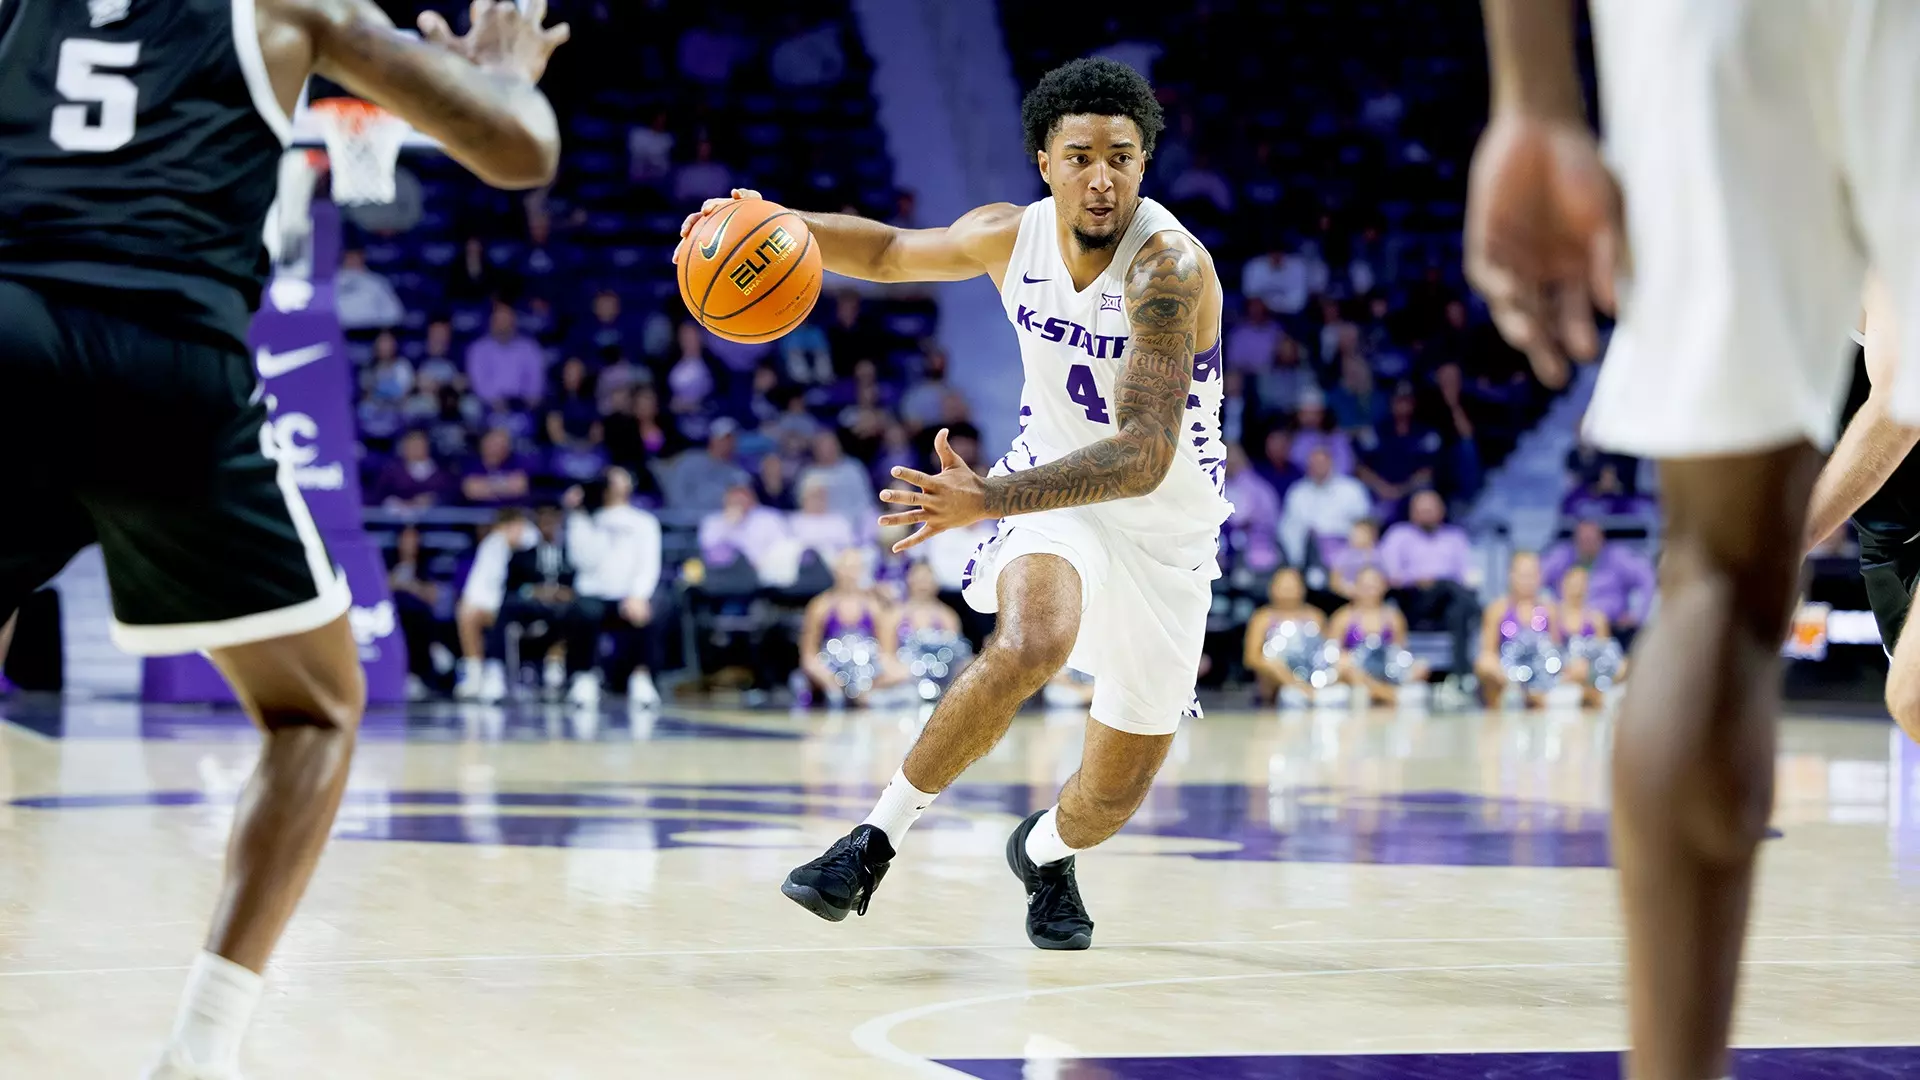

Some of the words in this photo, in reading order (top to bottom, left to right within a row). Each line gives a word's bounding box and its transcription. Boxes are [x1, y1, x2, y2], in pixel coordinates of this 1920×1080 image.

[50, 37, 141, 152] 5
[728, 225, 796, 292] ELITE
[743, 240, 799, 296] CHAMNSHIP
[1065, 364, 1111, 425] 4
